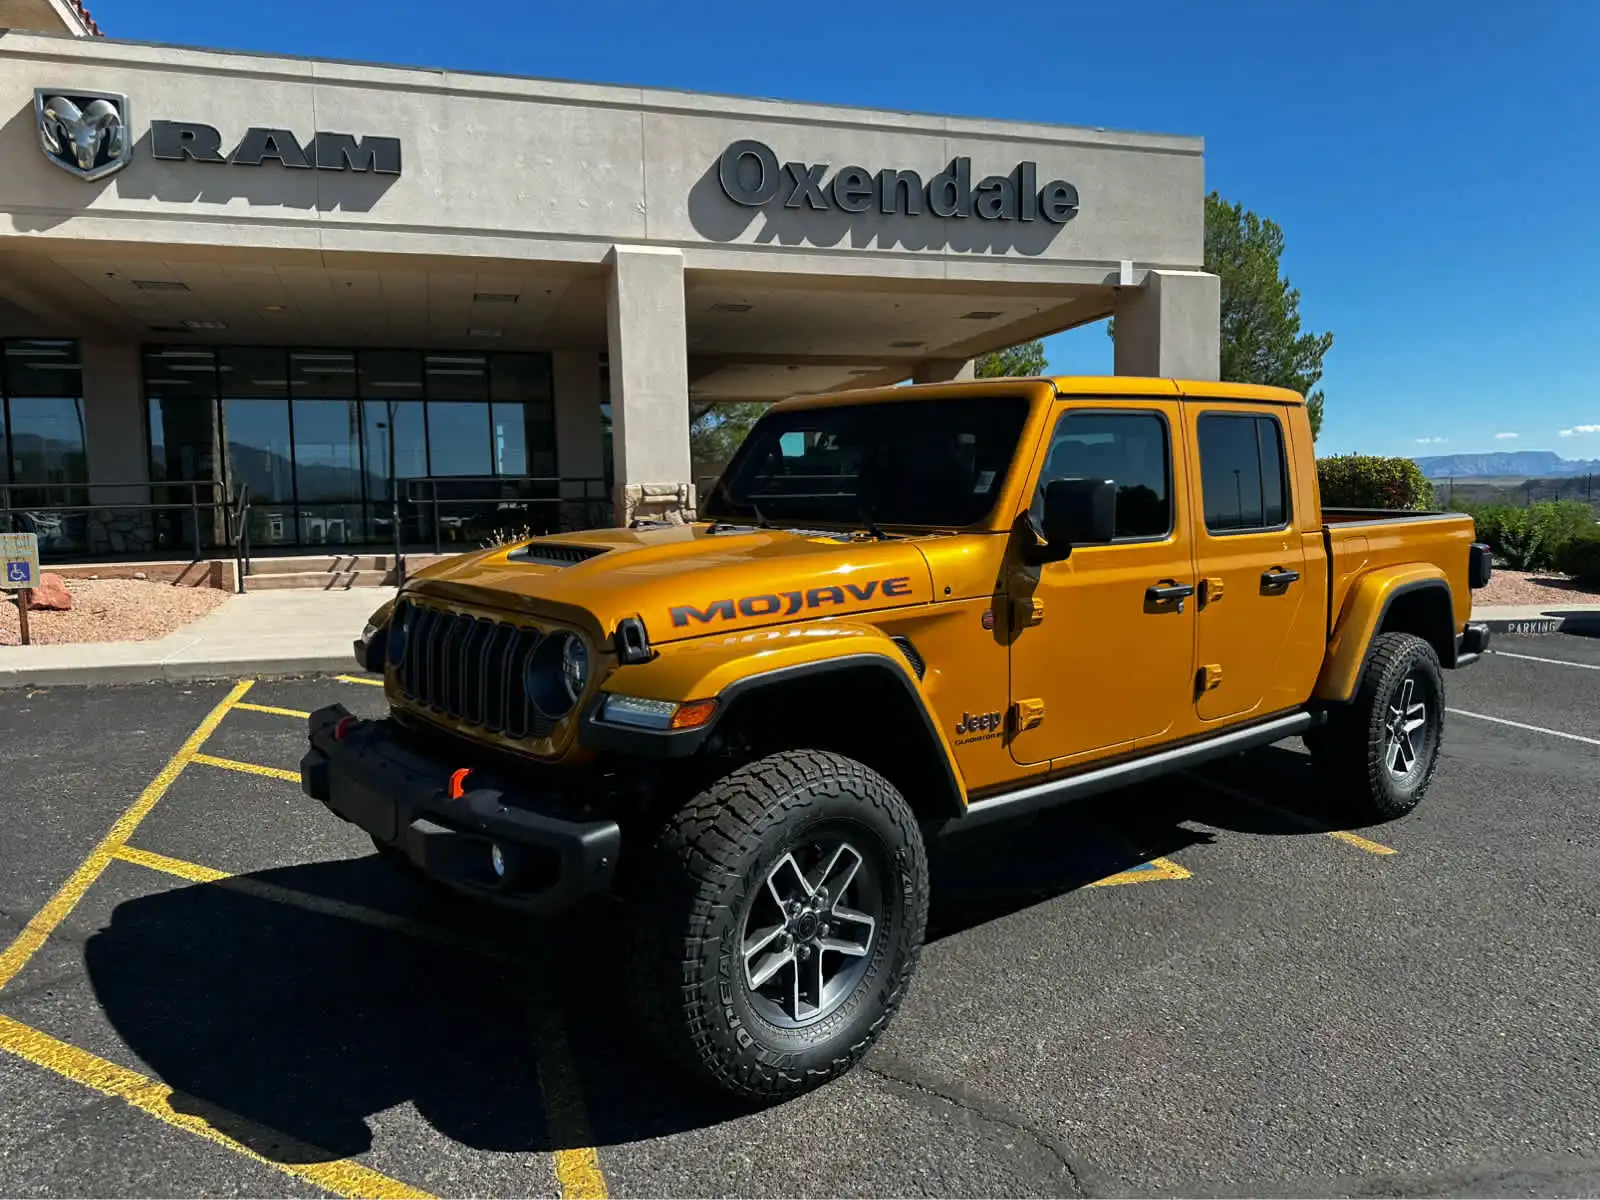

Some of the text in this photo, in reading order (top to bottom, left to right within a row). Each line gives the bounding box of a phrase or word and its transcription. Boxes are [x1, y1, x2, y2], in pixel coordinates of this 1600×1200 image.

[151, 120, 402, 174] RAM
[719, 140, 1079, 224] Oxendale
[670, 576, 913, 626] MOJAVE
[1508, 621, 1558, 634] PARKING
[956, 711, 1001, 734] Jeep
